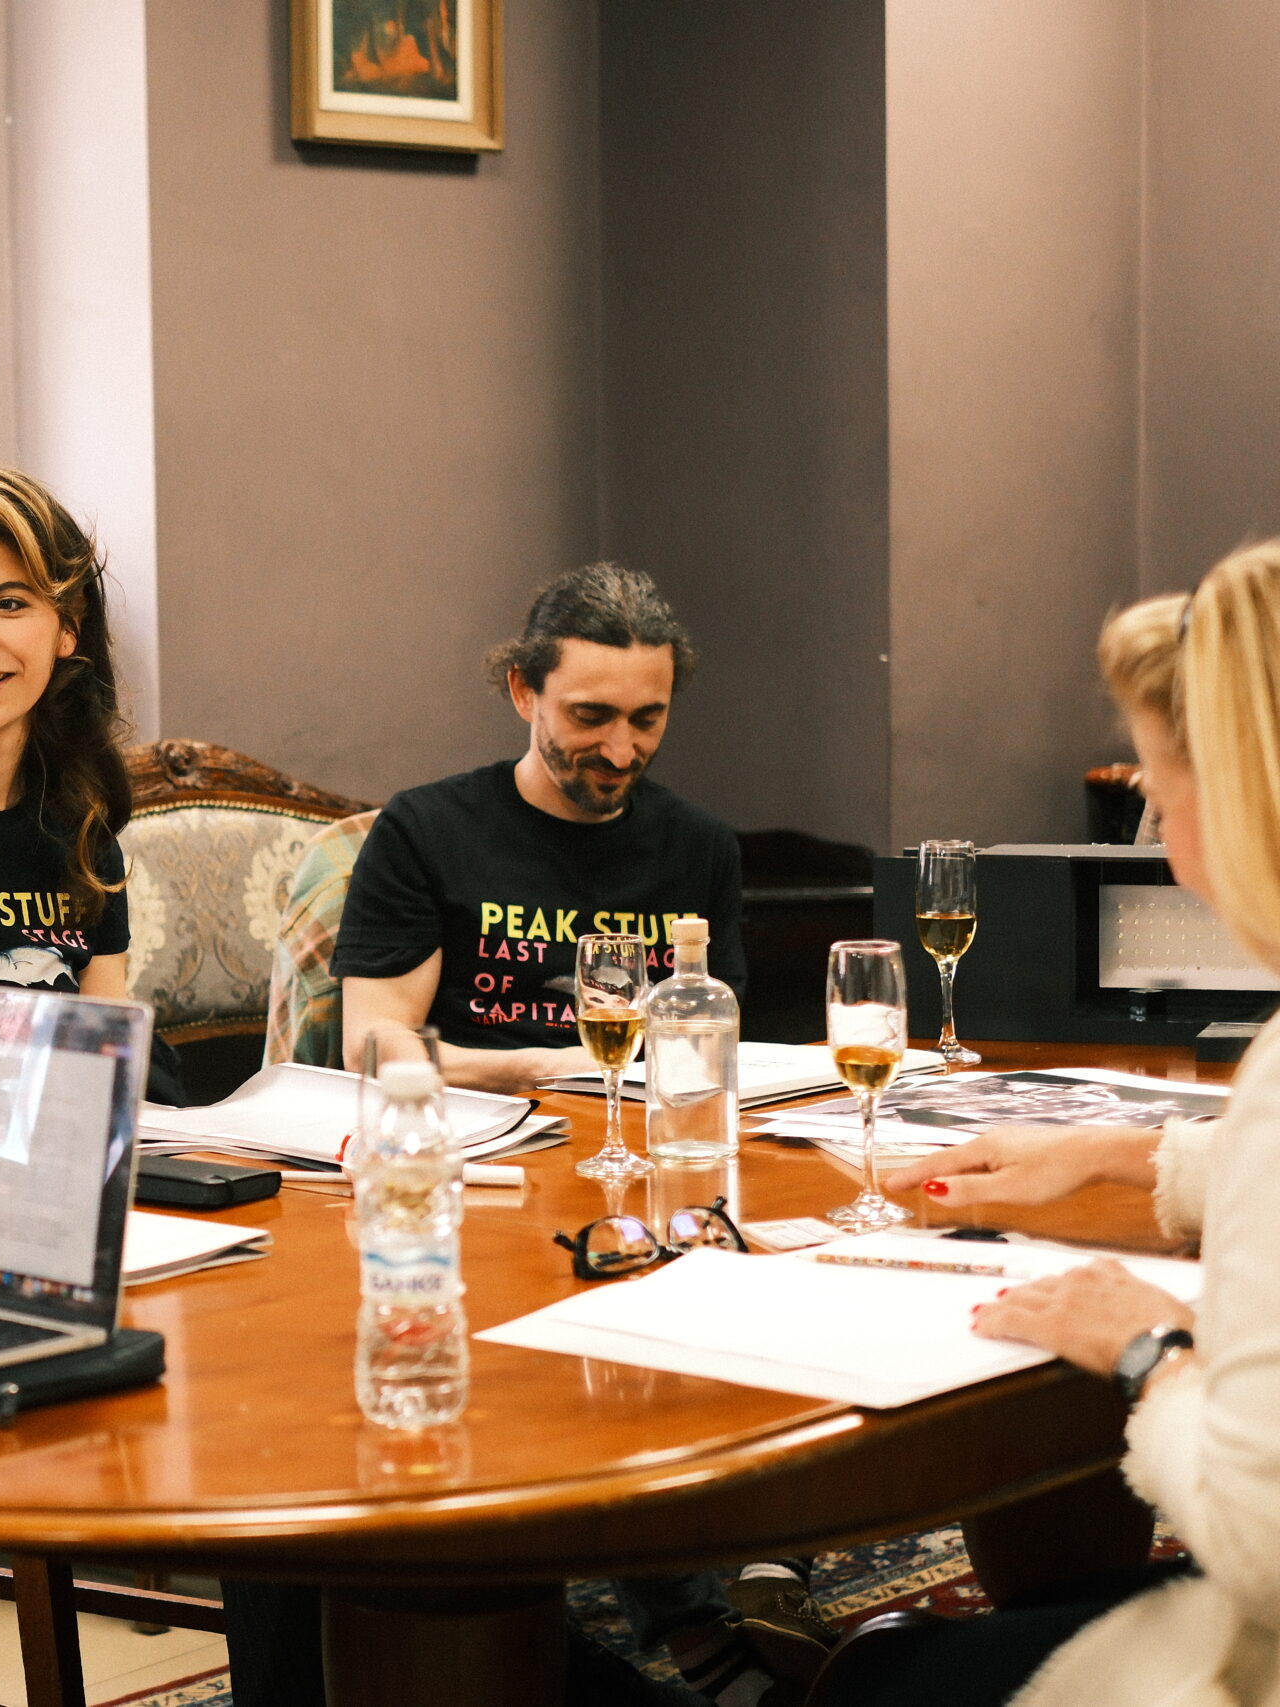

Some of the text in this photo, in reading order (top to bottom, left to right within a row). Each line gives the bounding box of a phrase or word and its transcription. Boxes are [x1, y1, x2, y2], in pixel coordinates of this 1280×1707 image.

[481, 901, 699, 946] PEAK STUF
[21, 929, 89, 950] STAGE
[478, 937, 548, 963] LAST
[474, 973, 514, 994] OF
[469, 998, 577, 1023] CAPITA
